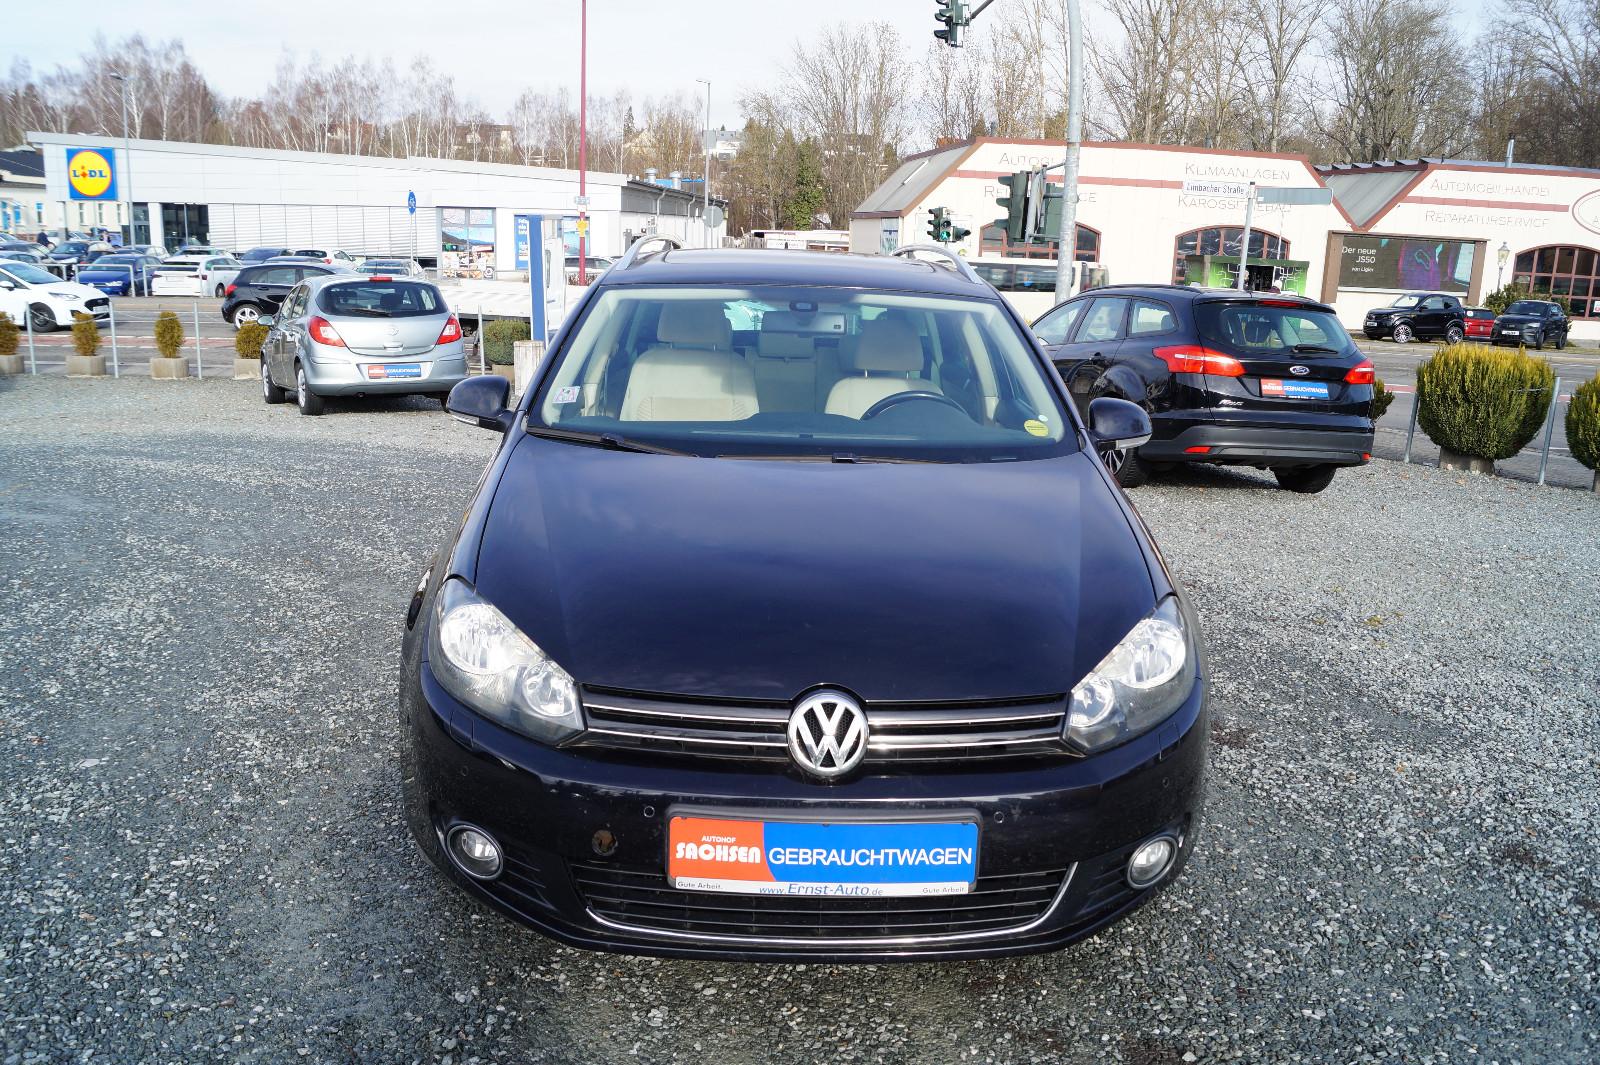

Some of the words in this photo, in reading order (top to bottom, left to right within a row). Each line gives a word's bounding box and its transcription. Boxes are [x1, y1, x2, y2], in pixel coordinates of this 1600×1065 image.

[999, 152, 1066, 167] AUTOGL
[72, 165, 107, 178] LIDL
[1185, 162, 1290, 181] KLIMAANLAGEN
[1186, 183, 1221, 193] Limbacher
[1223, 185, 1244, 195] Straße
[1342, 246, 1356, 254] Der
[794, 701, 863, 770] VW
[701, 835, 737, 844] AUTOHOF
[675, 842, 761, 864] SACHSEN
[768, 847, 972, 866] GEBRAUCHTWAGEN
[759, 883, 884, 896] www.Ernst-Auto.de
